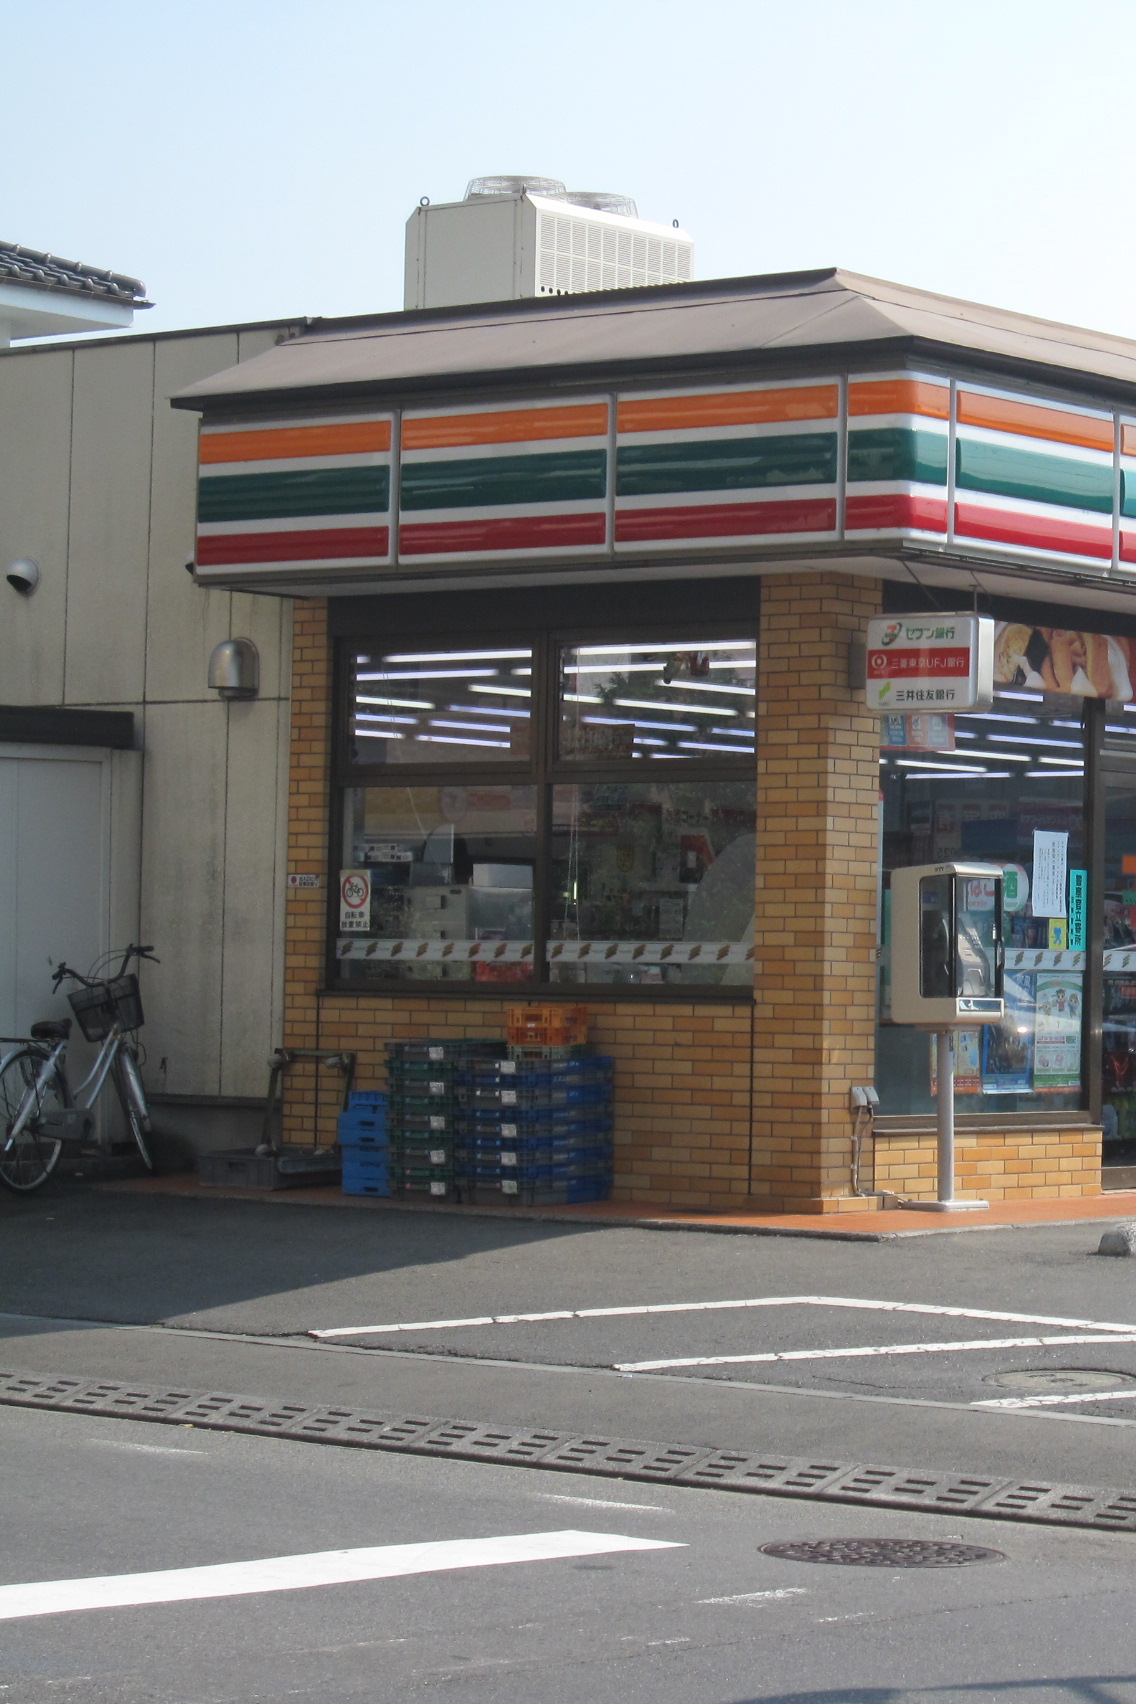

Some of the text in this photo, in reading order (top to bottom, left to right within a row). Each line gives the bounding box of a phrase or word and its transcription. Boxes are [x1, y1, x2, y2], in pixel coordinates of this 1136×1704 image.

[905, 626, 956, 641] セブン銀行
[891, 656, 965, 669] 三菱東京UFJ銀行
[895, 689, 956, 701] 三井住友銀行
[344, 911, 365, 919] 自転車
